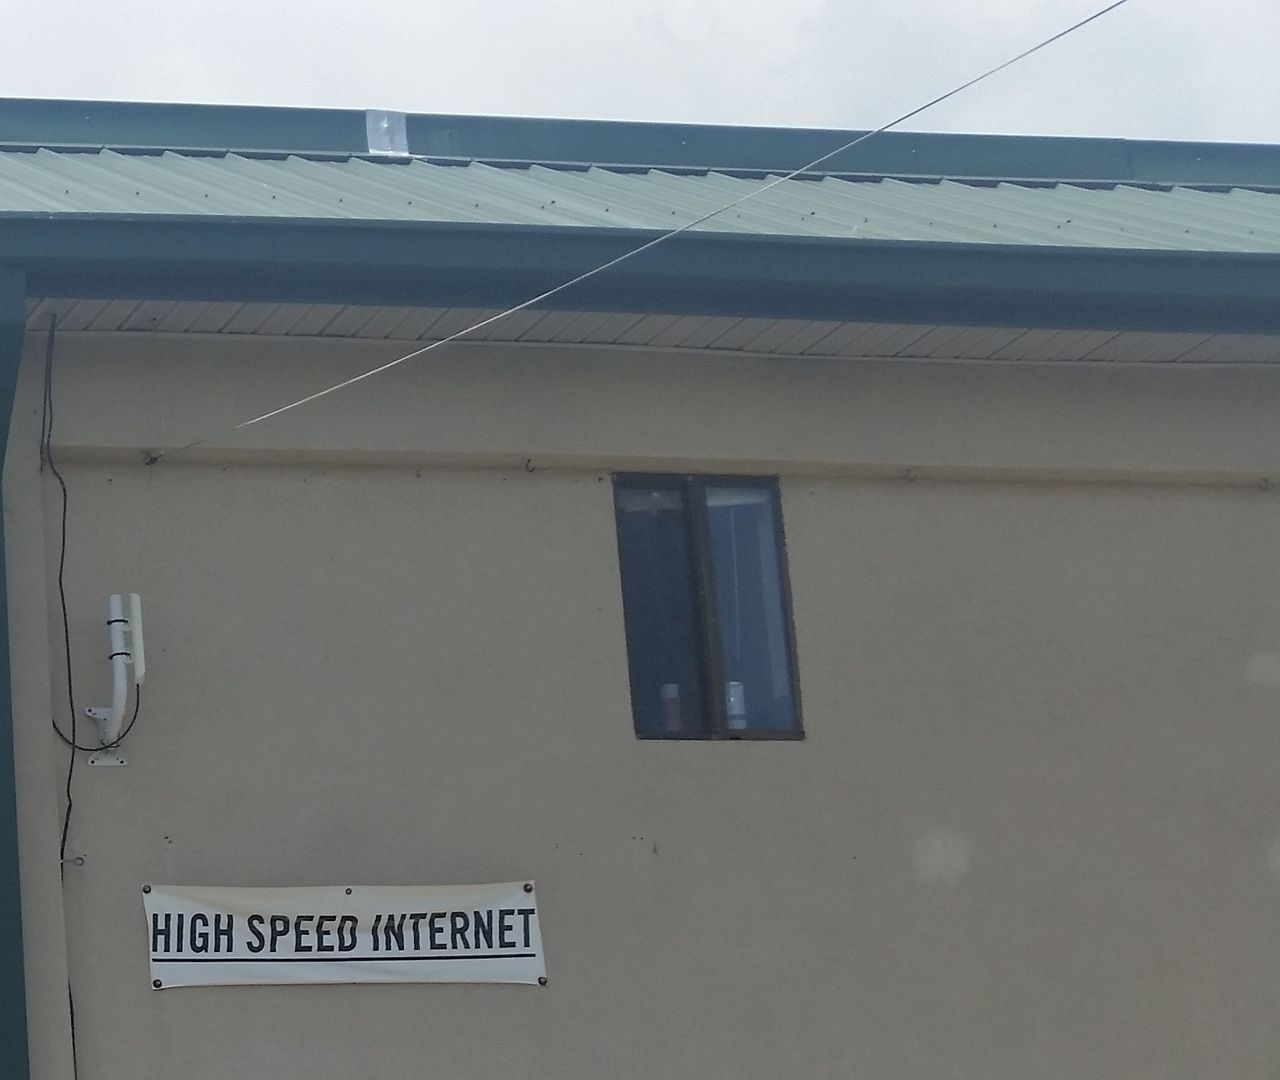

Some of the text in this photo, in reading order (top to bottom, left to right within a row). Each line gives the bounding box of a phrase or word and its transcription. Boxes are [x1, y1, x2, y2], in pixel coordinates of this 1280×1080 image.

[151, 908, 536, 954] HIGH SPEED INTERNET
